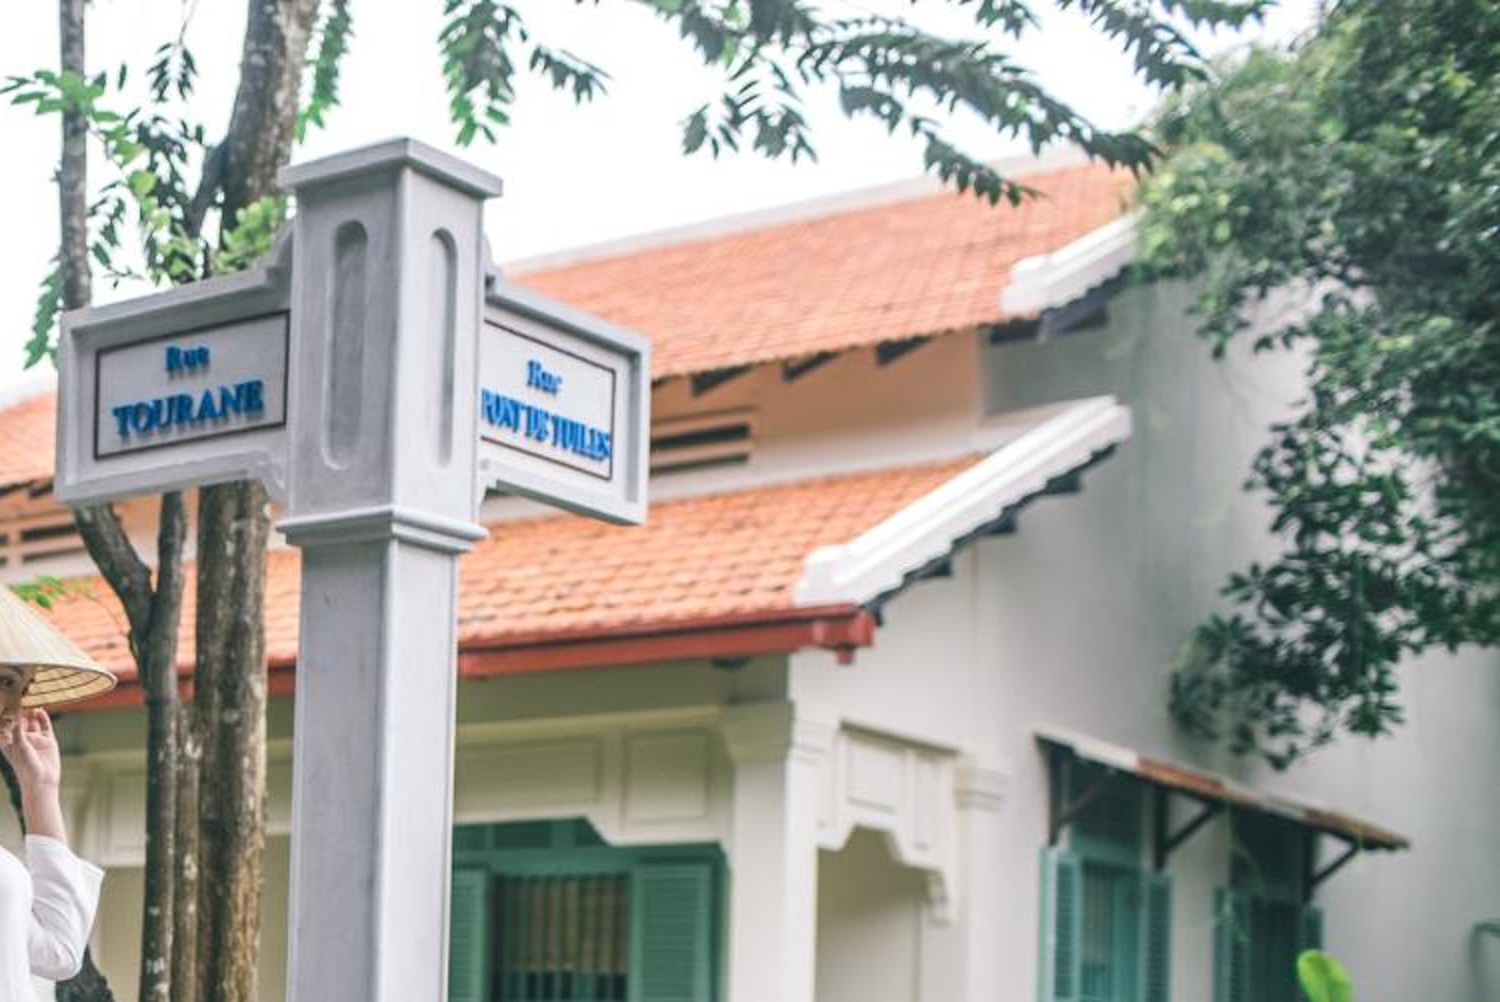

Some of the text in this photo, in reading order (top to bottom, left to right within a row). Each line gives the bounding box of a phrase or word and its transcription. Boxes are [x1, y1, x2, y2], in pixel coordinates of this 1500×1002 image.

[165, 346, 211, 372] Rue
[527, 360, 562, 394] Rue
[112, 379, 264, 436] TOURANE
